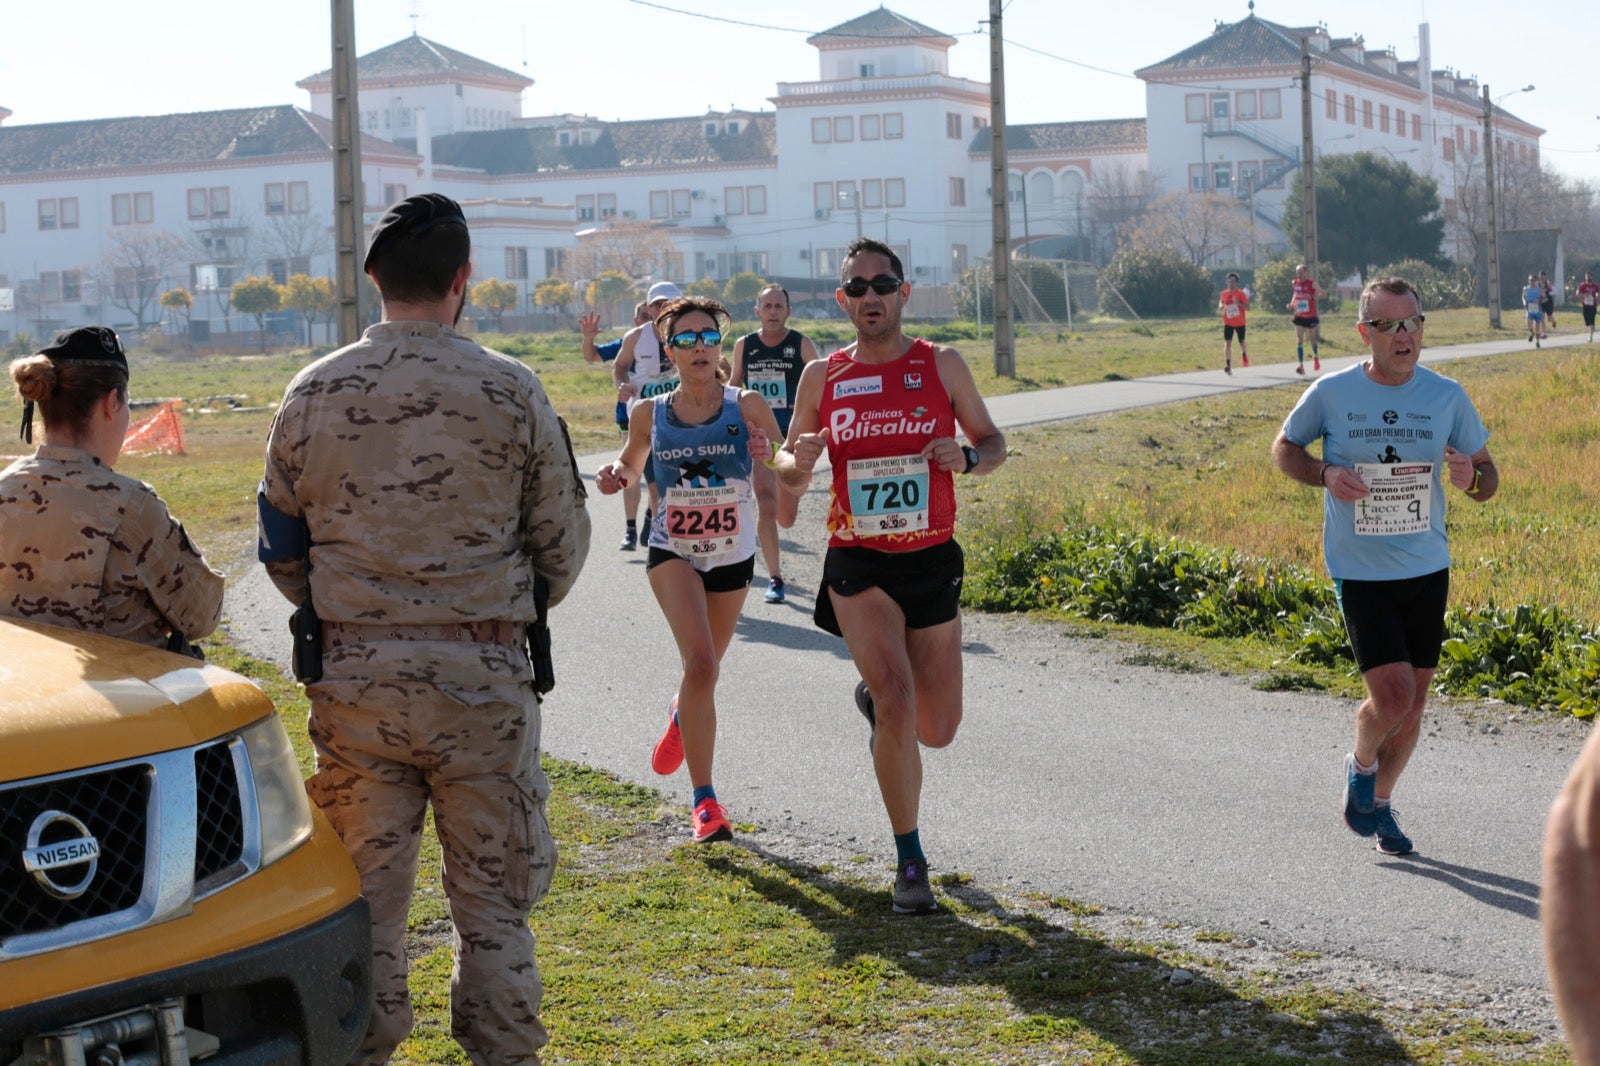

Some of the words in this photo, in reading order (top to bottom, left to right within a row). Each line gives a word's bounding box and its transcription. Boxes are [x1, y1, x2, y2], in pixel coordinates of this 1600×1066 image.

[861, 410, 903, 420] Clínicas
[831, 407, 936, 445] Polisalud
[1365, 429, 1381, 437] GRAN
[1383, 428, 1405, 438] PREMIO
[1407, 429, 1414, 438] DE
[1416, 430, 1433, 440] FONDO
[656, 447, 693, 461] TODO
[697, 444, 735, 456] SUMA
[861, 480, 919, 510] 720
[1400, 484, 1428, 492] CONTRA
[671, 507, 736, 535] 2245
[37, 841, 97, 865] NISSAN
